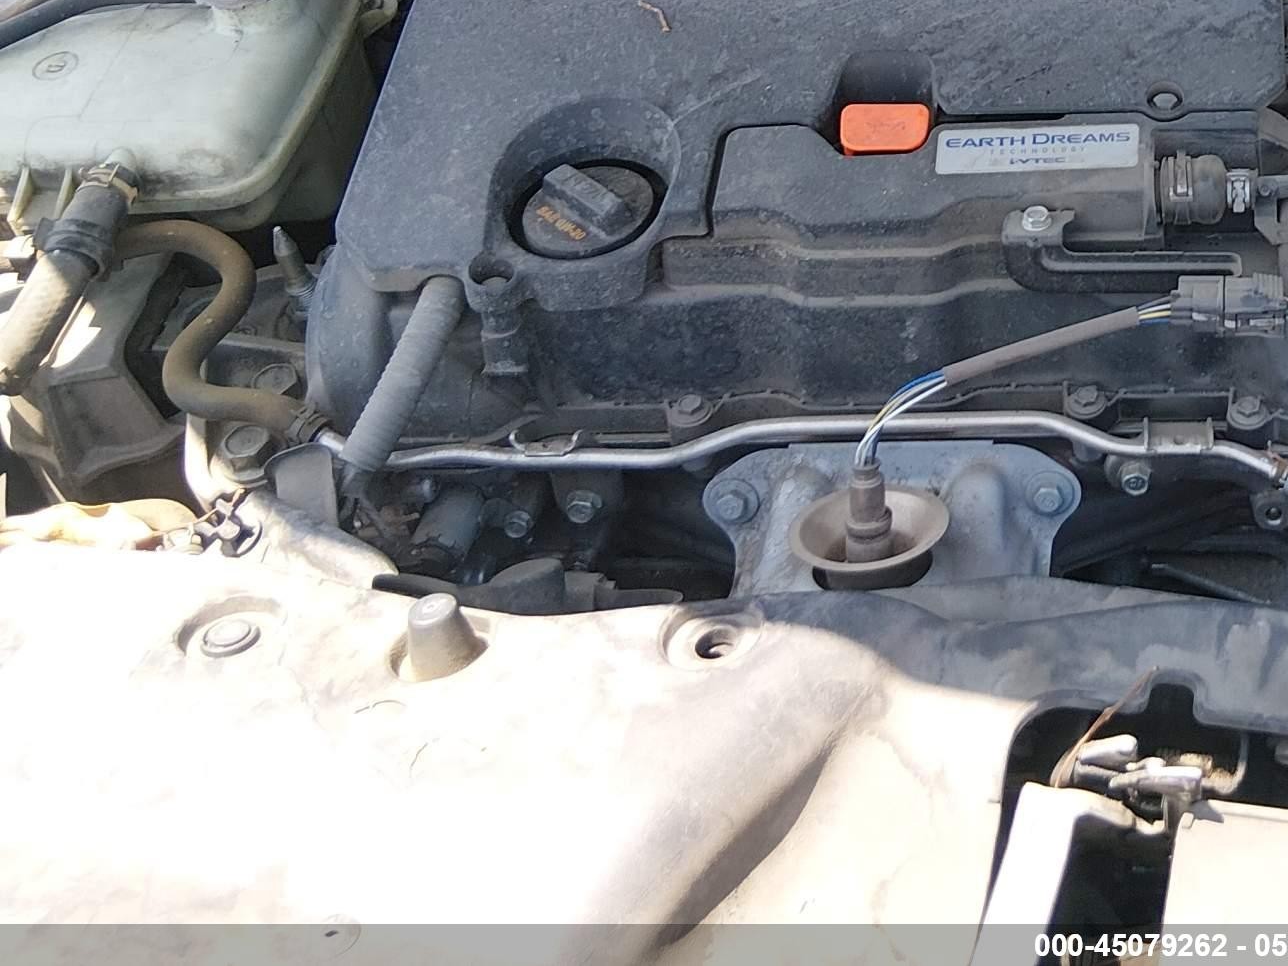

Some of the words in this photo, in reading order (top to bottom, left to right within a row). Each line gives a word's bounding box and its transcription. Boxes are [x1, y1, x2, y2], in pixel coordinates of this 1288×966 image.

[945, 136, 1025, 148] EARTH
[1031, 132, 1131, 145] DREAMS
[990, 146, 1086, 156] TECHNOLOGY
[1009, 157, 1067, 165] i-VTEC
